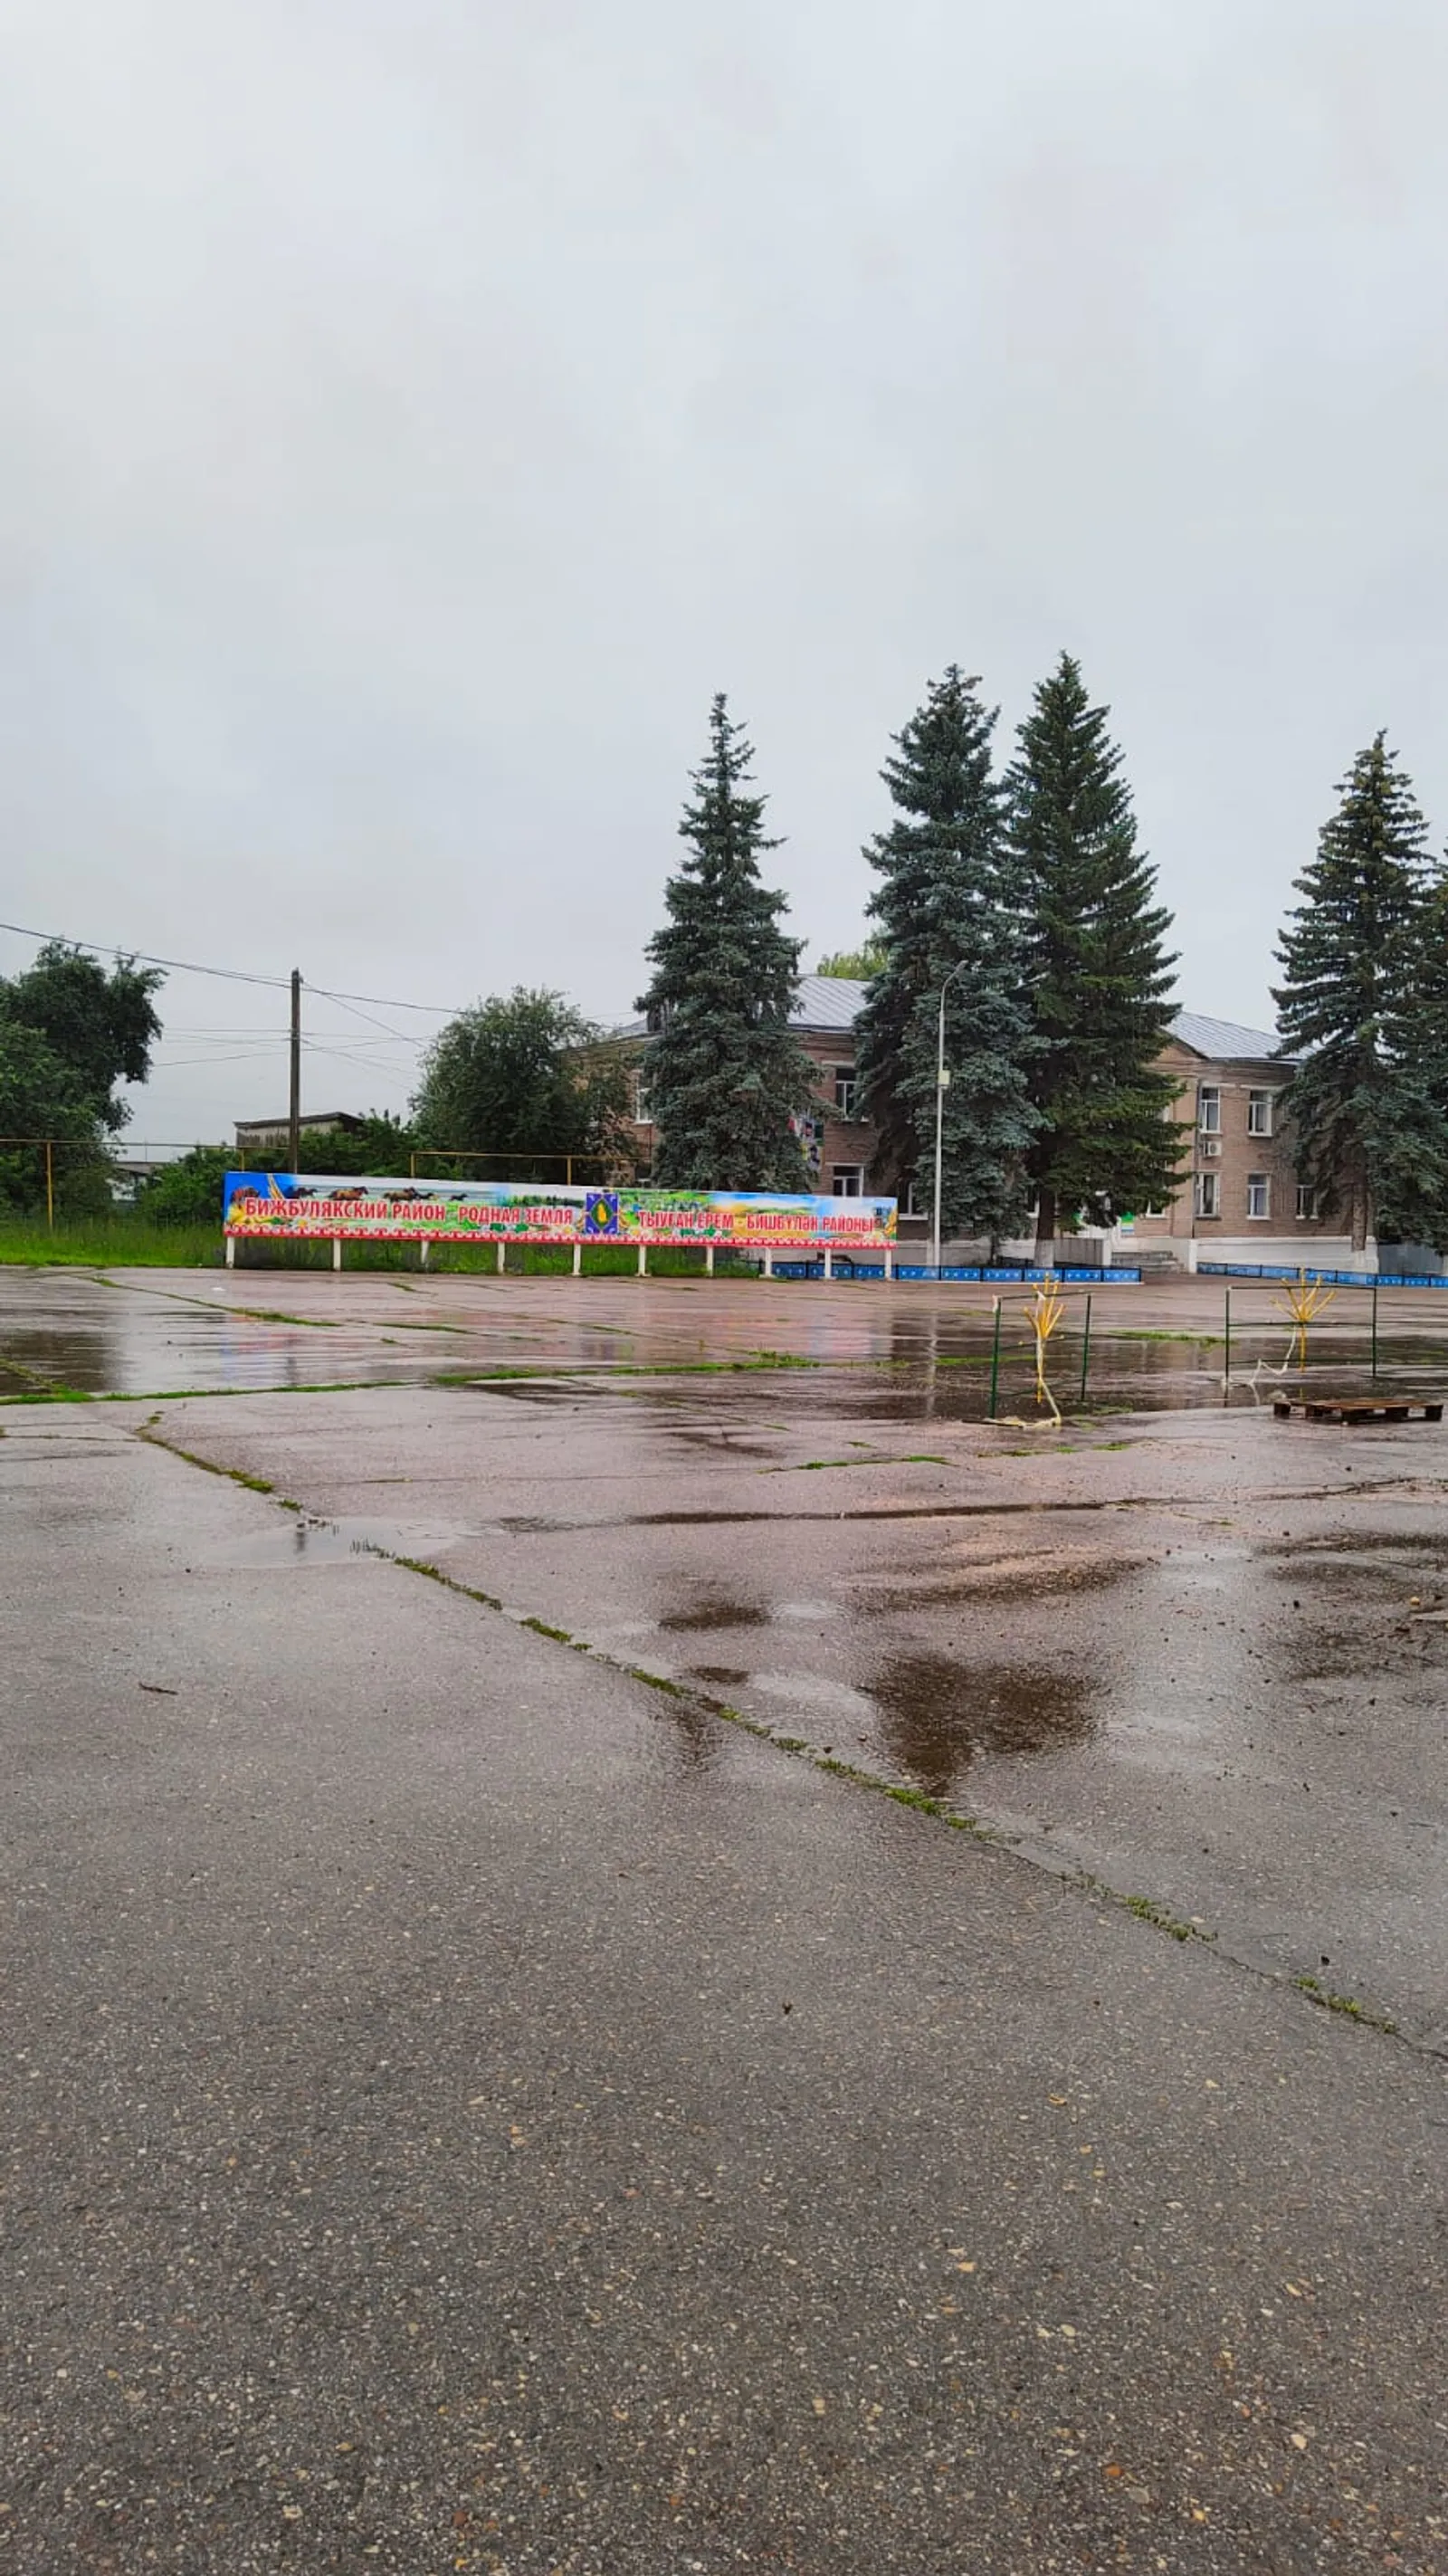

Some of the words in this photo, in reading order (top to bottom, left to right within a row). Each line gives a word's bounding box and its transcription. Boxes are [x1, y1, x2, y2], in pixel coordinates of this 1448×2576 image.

[245, 1197, 387, 1219] БИЖБУЛЯКСКИЙ
[392, 1200, 446, 1221] РАЙОН
[458, 1206, 520, 1224] РОДНАЯ
[525, 1207, 573, 1226] ЗЕМЛЯ
[822, 1214, 873, 1233] РАЙОНЫ
